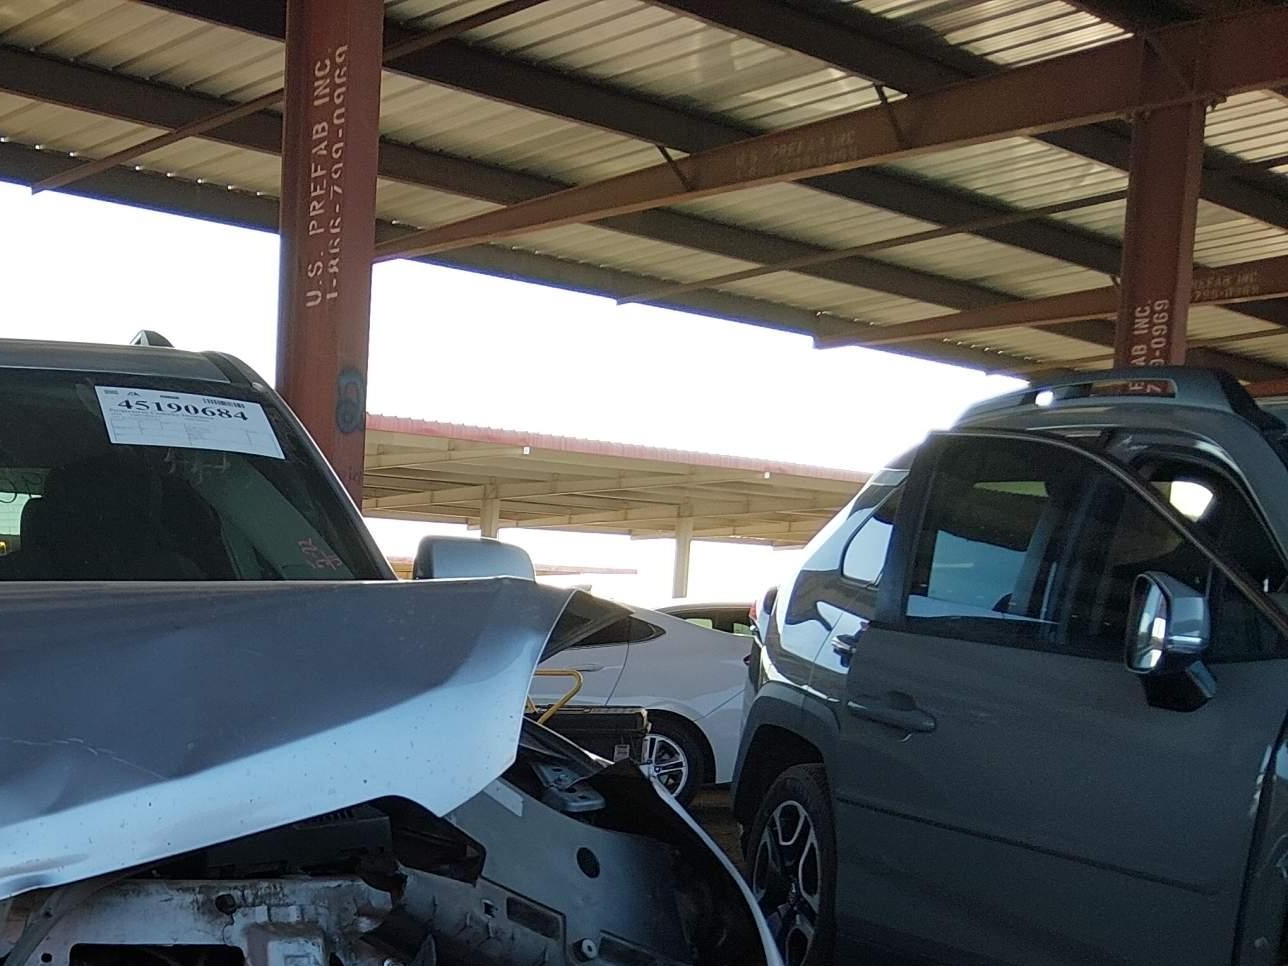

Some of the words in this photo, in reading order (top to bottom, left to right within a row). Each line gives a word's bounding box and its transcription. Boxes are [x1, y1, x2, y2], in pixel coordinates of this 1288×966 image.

[309, 120, 329, 237] PREFAB
[305, 250, 325, 308] U.S.
[117, 398, 249, 421] 45190684
